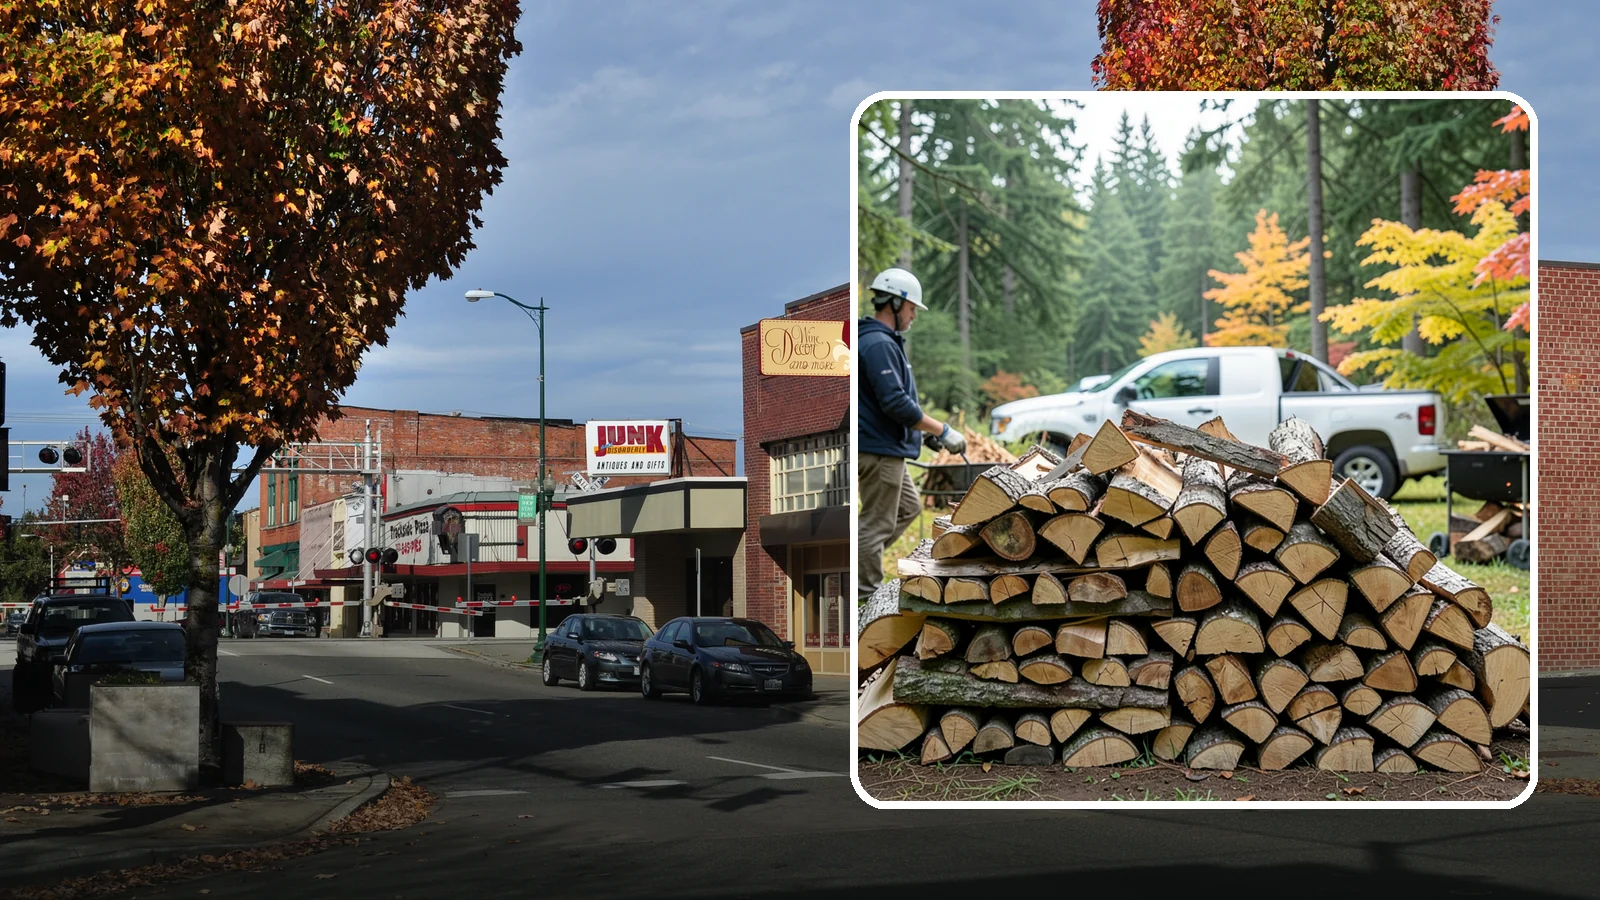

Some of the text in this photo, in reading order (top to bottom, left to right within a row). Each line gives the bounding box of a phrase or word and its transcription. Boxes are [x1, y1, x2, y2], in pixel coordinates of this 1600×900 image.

[595, 425, 665, 457] JUNK
[607, 446, 646, 454] DISORDERLY
[596, 460, 665, 470] ANTIQUES AND GIFTS
[414, 519, 429, 535] Pizza
